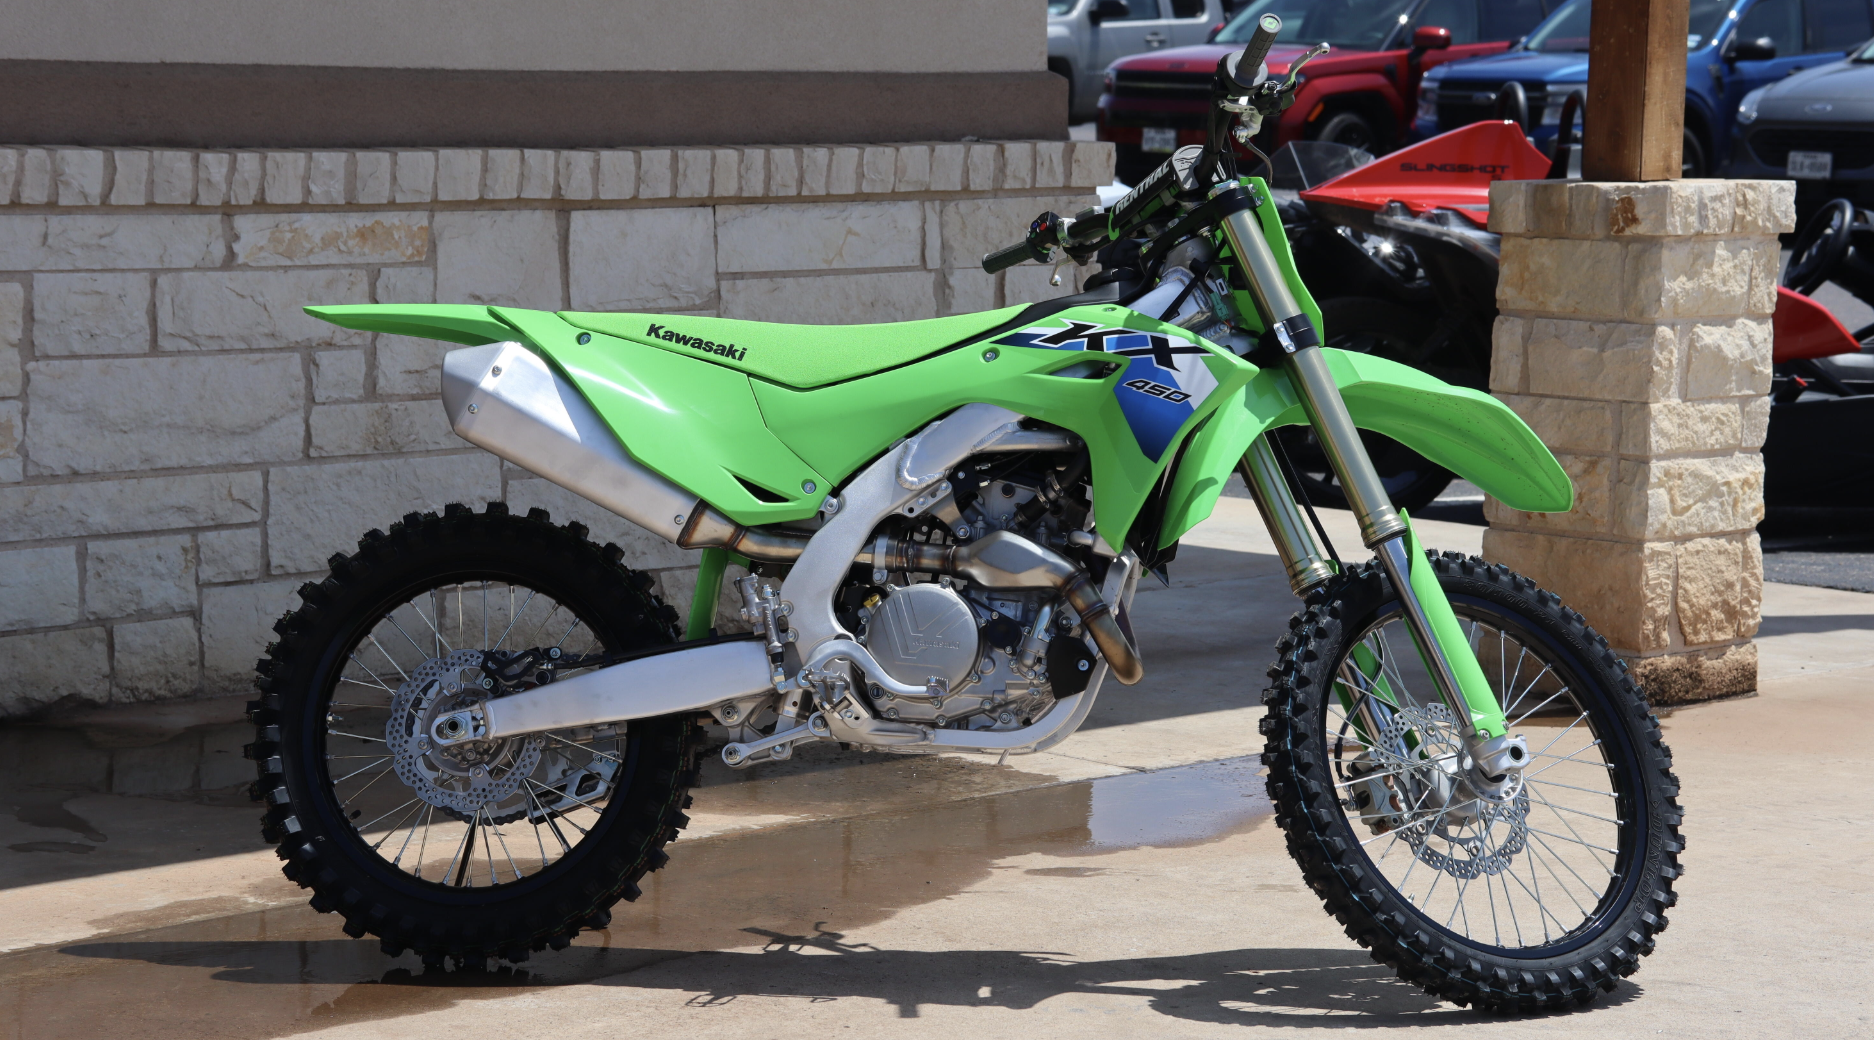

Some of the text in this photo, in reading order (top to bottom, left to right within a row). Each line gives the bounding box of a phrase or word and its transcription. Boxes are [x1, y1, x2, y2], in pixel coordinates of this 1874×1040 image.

[1400, 162, 1510, 174] SLINGSHOT
[1115, 162, 1170, 215] RENTHAL
[646, 323, 748, 362] Kawasaki
[1031, 319, 1215, 373] KX
[1123, 379, 1192, 404] 450
